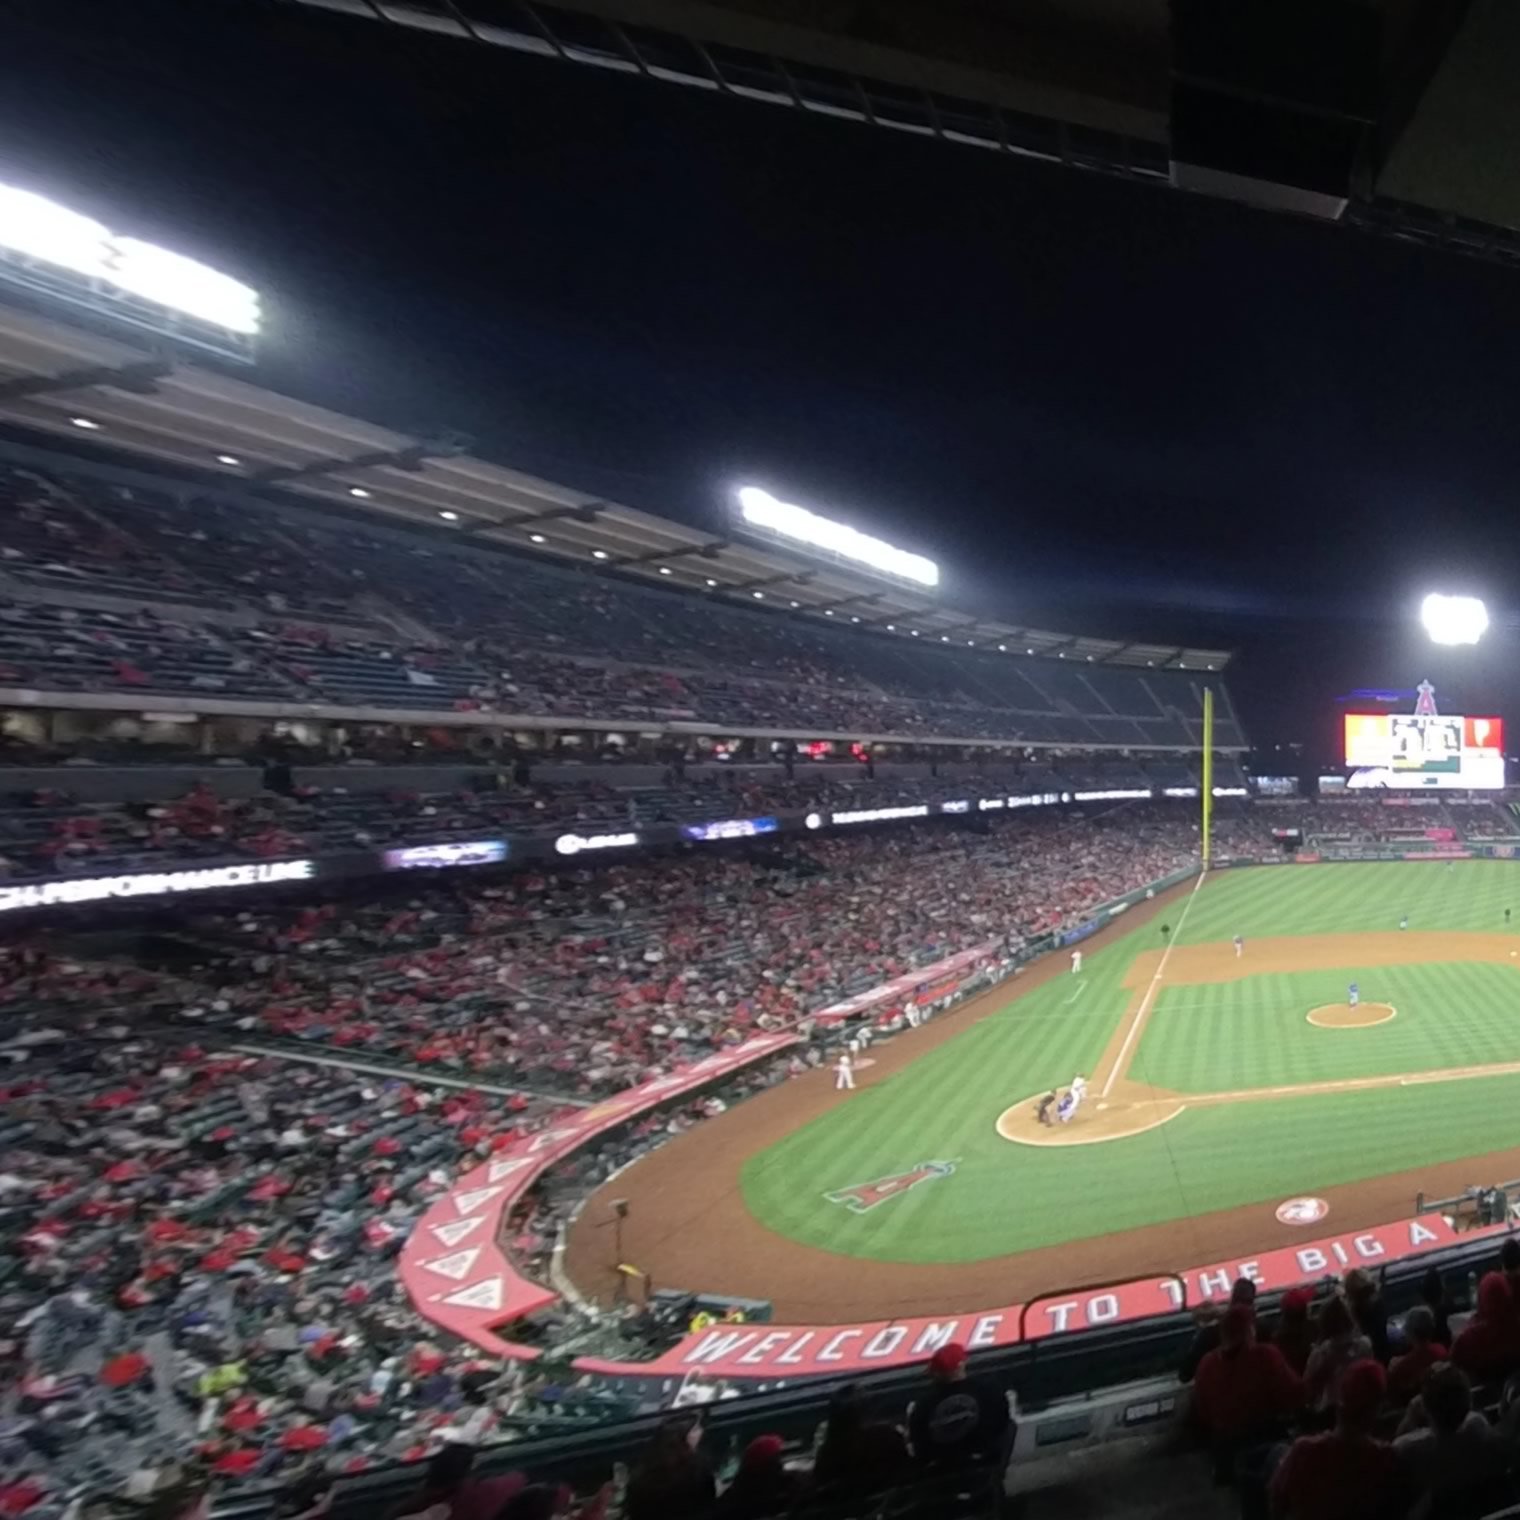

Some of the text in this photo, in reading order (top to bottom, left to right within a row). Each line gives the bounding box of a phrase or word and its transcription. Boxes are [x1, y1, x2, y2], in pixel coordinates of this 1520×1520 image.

[687, 1221, 1439, 1363] WELCOME TO THE BIG A
